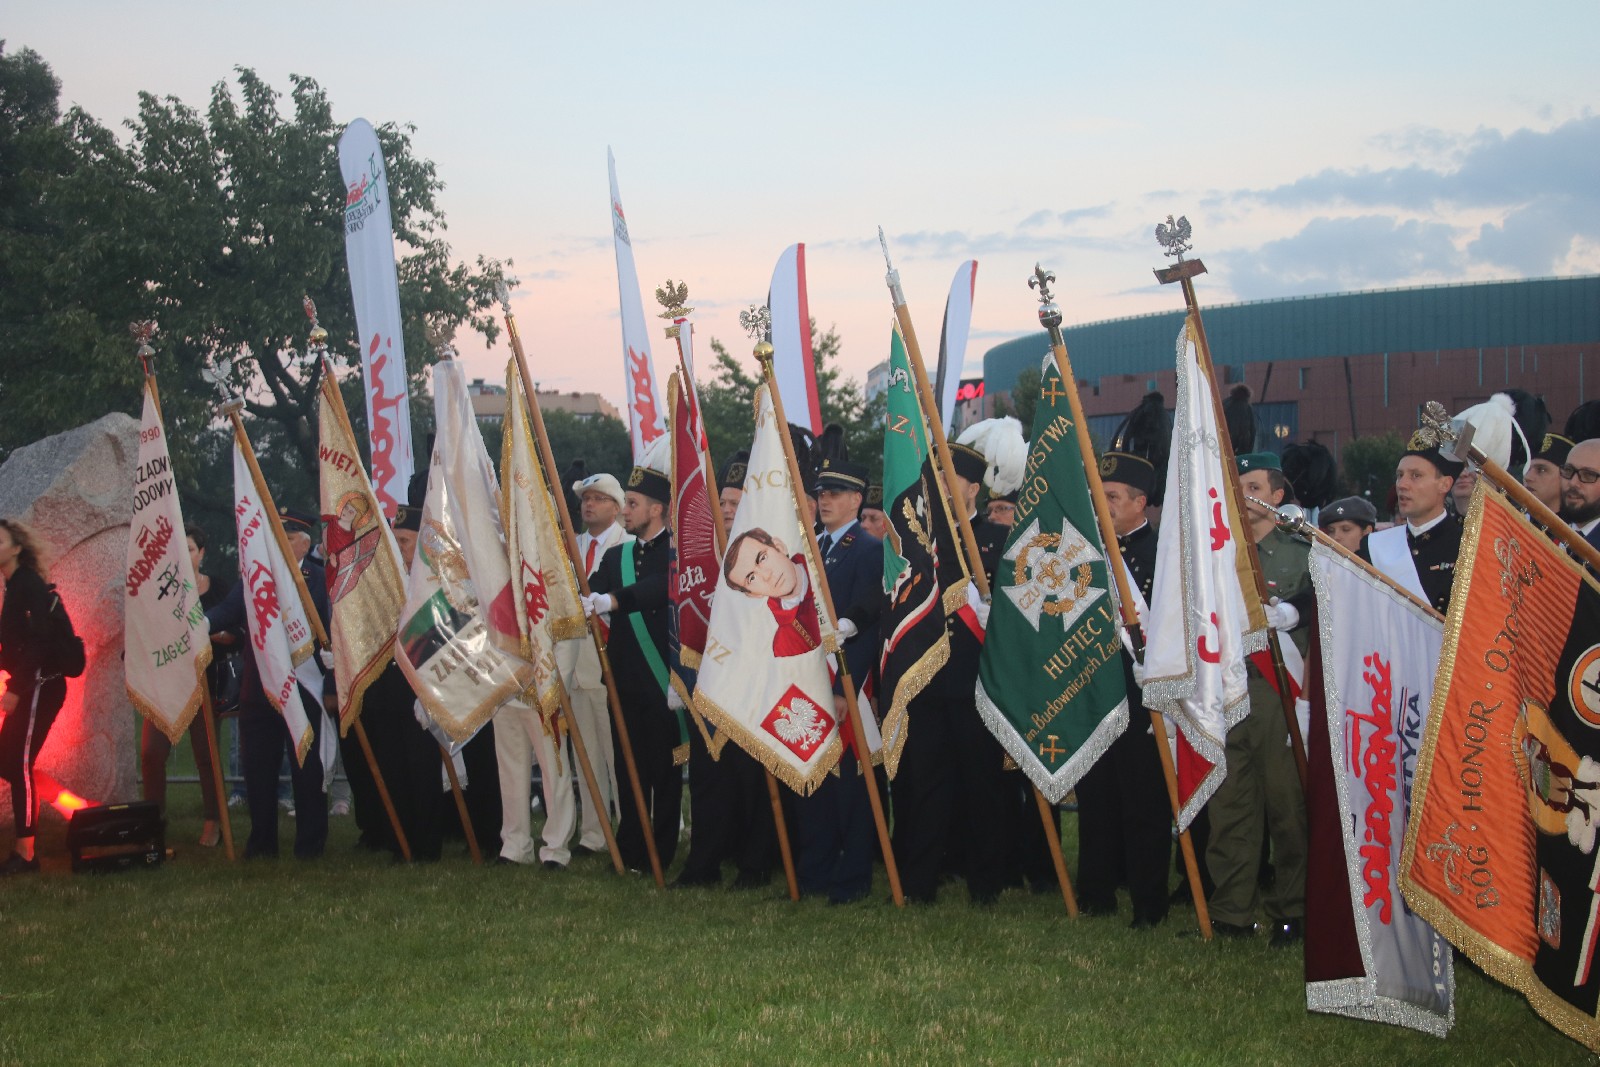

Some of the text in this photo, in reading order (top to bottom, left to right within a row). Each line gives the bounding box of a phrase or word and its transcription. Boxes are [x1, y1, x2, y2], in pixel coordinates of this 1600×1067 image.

[1042, 616, 1103, 682] HUFIEC
[1030, 655, 1102, 732] Budowniczych
[1461, 697, 1503, 814] HONOR
[1466, 843, 1502, 912] BÓG
